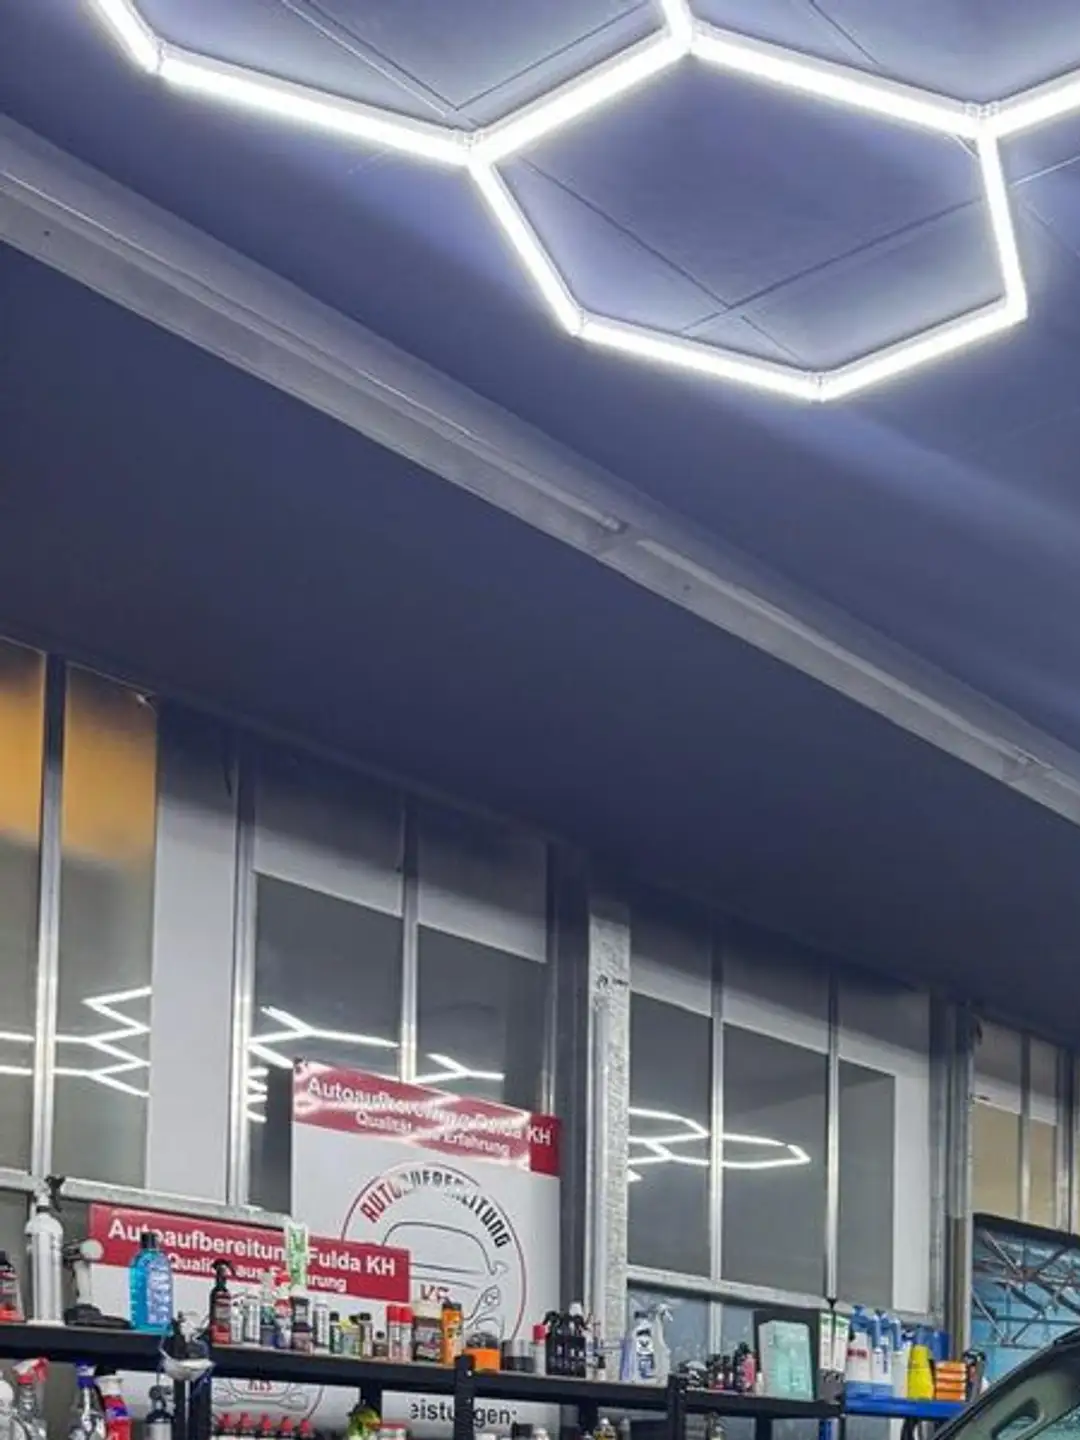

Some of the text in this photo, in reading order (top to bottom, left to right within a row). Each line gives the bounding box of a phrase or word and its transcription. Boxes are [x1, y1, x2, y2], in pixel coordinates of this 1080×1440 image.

[528, 1126, 551, 1145] KH
[108, 1218, 292, 1260] Autoaufbereitun
[366, 1257, 396, 1277] KH
